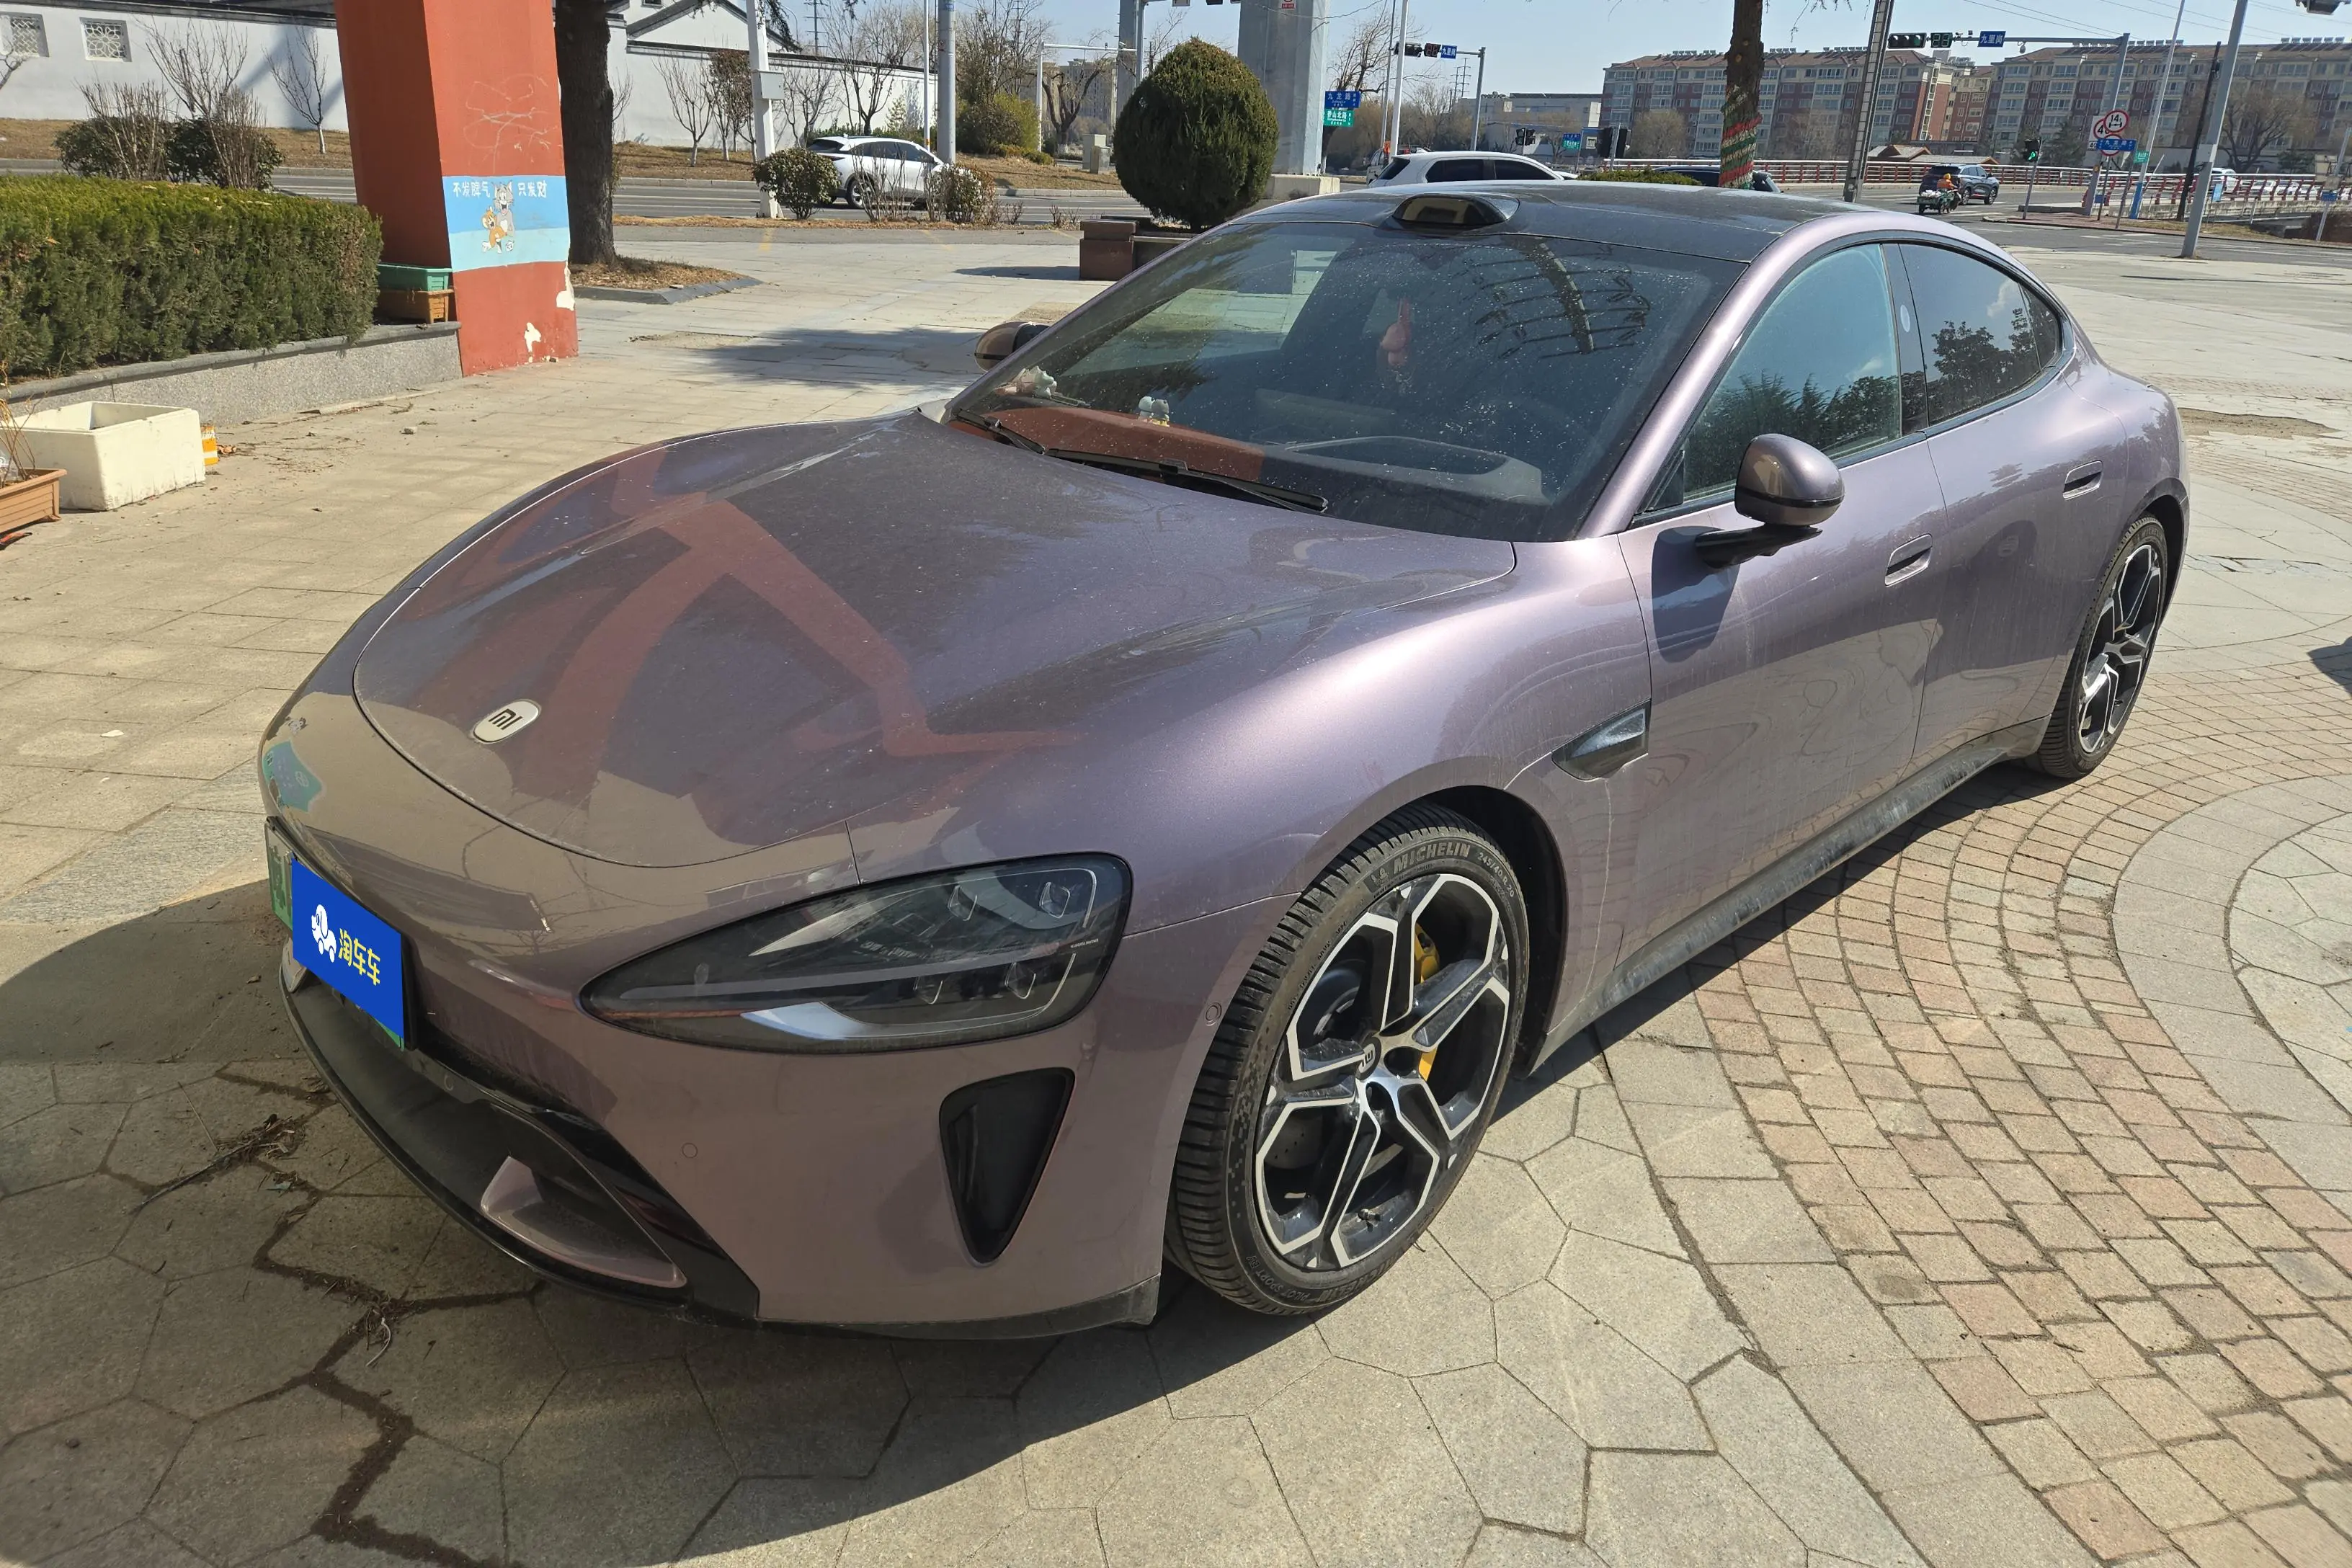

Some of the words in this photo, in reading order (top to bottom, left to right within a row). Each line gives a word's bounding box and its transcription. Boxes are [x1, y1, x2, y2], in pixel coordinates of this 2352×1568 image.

[453, 181, 491, 198] 不发脾气
[517, 180, 548, 198] 只发财
[1394, 842, 1471, 875] MICHELIN
[1478, 852, 1503, 876] 245/40
[1502, 876, 1509, 886] R
[1507, 884, 1515, 898] 20
[1255, 1270, 1284, 1293] SPORT
[1280, 1289, 1311, 1301] PILOT
